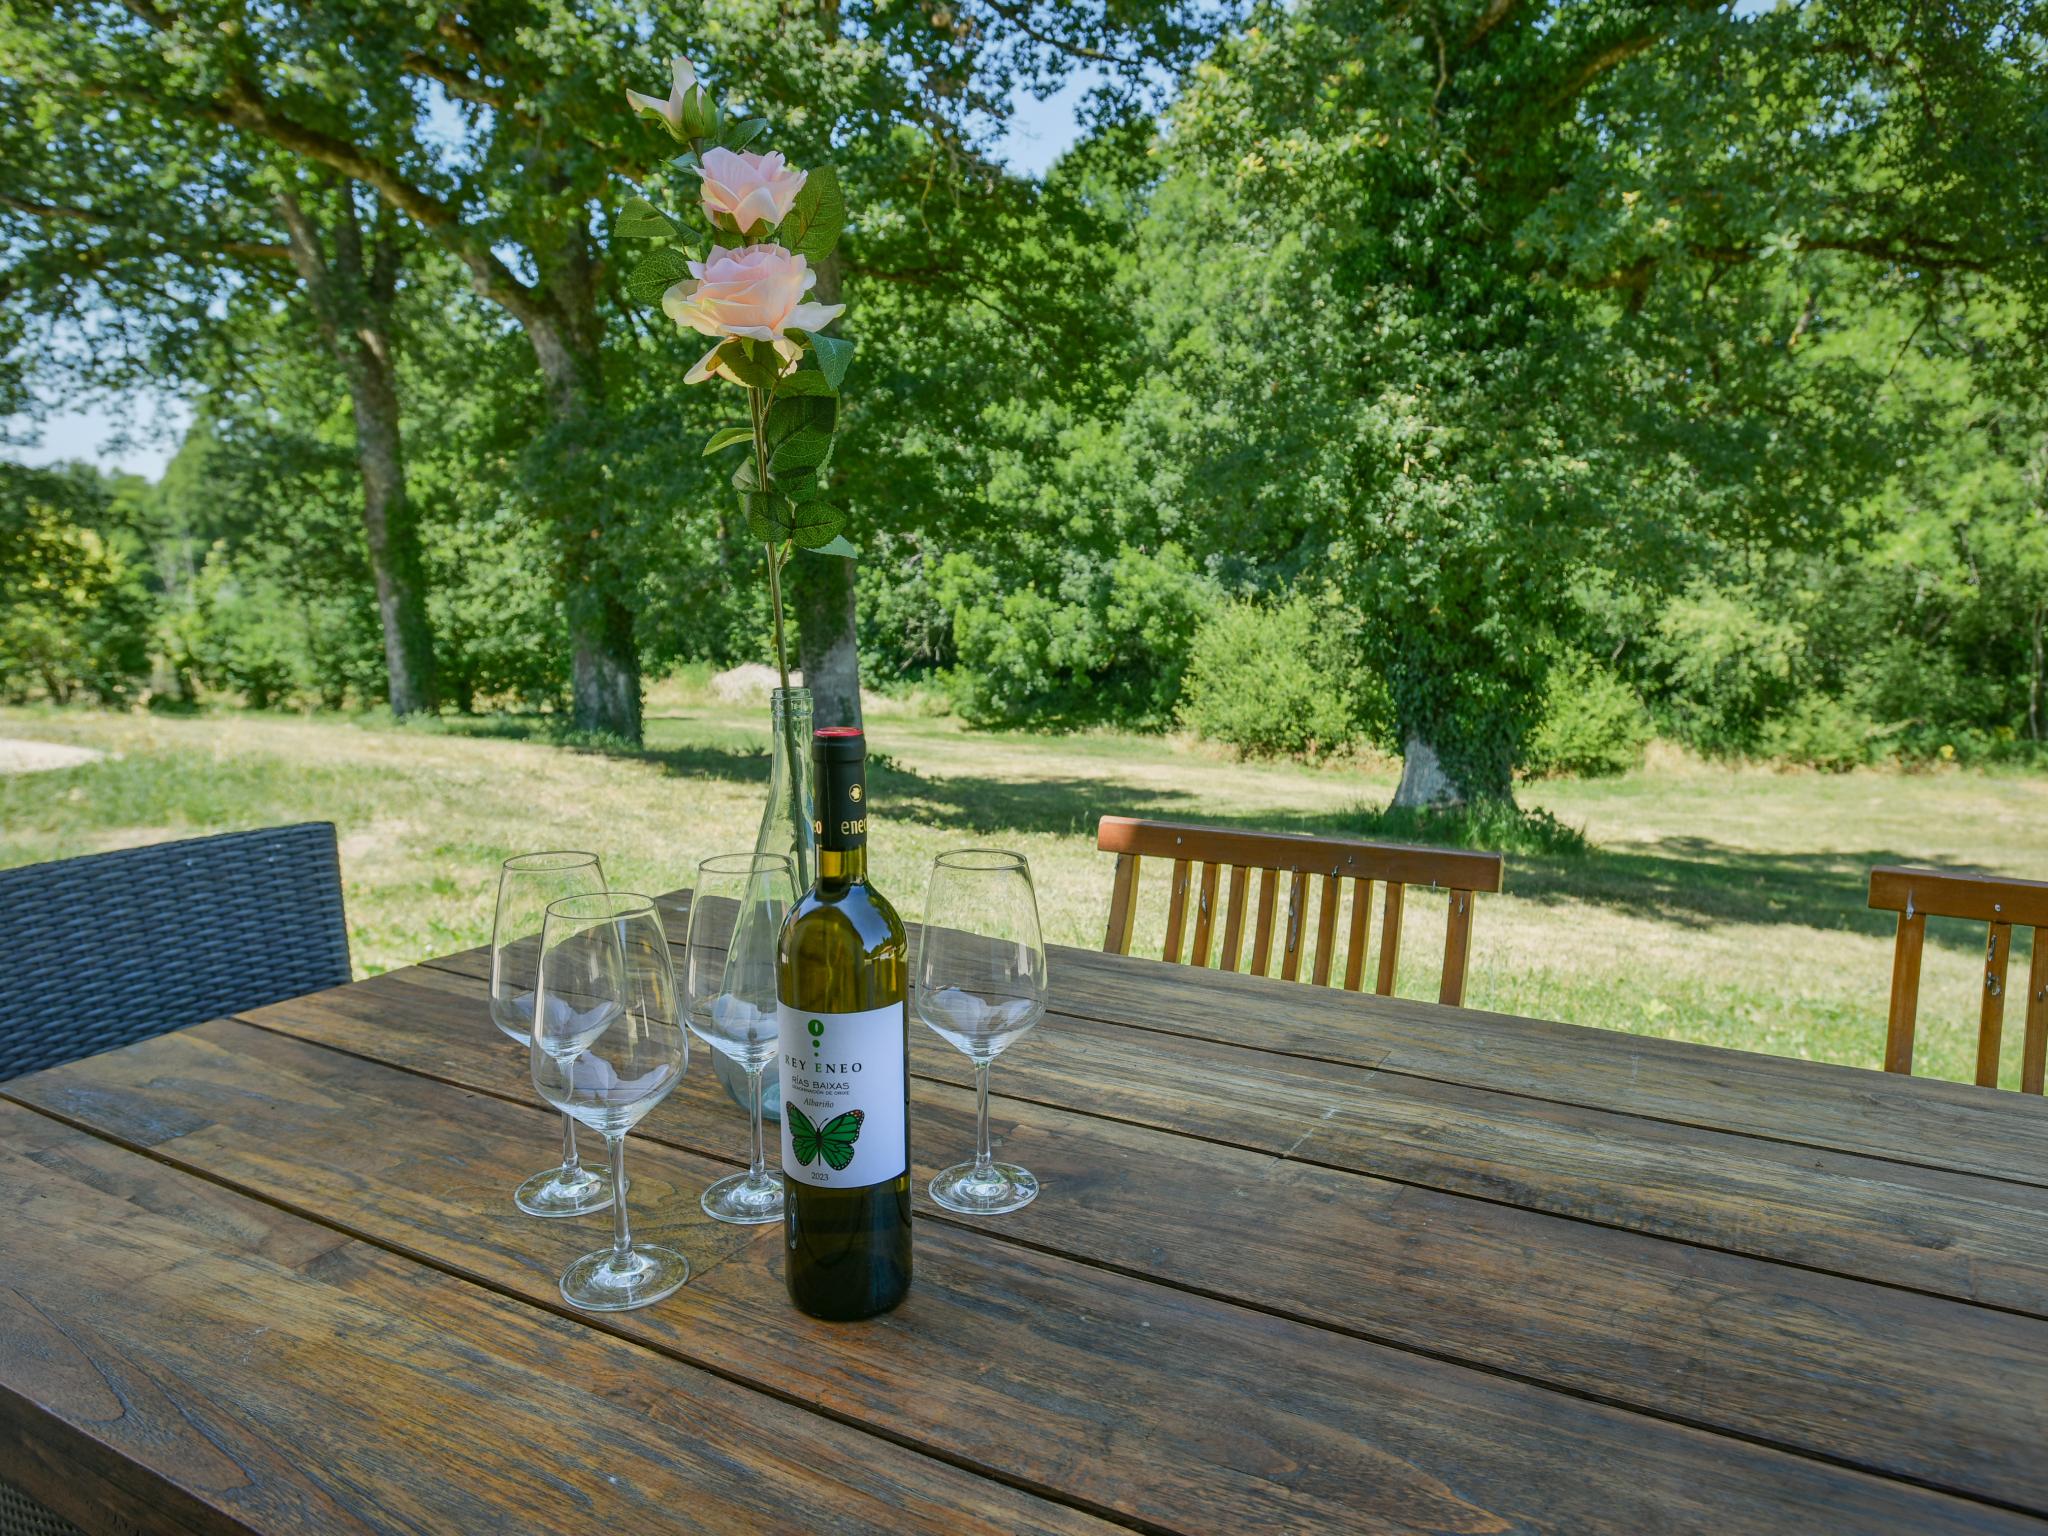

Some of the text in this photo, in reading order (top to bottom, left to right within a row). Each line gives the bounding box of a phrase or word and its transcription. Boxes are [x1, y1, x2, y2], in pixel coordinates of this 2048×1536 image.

[785, 1054, 862, 1073] REY ENEO
[792, 1075, 849, 1090] RÍAS BAIXAS
[804, 1098, 834, 1109] Albariño
[811, 1171, 829, 1181] 2023
